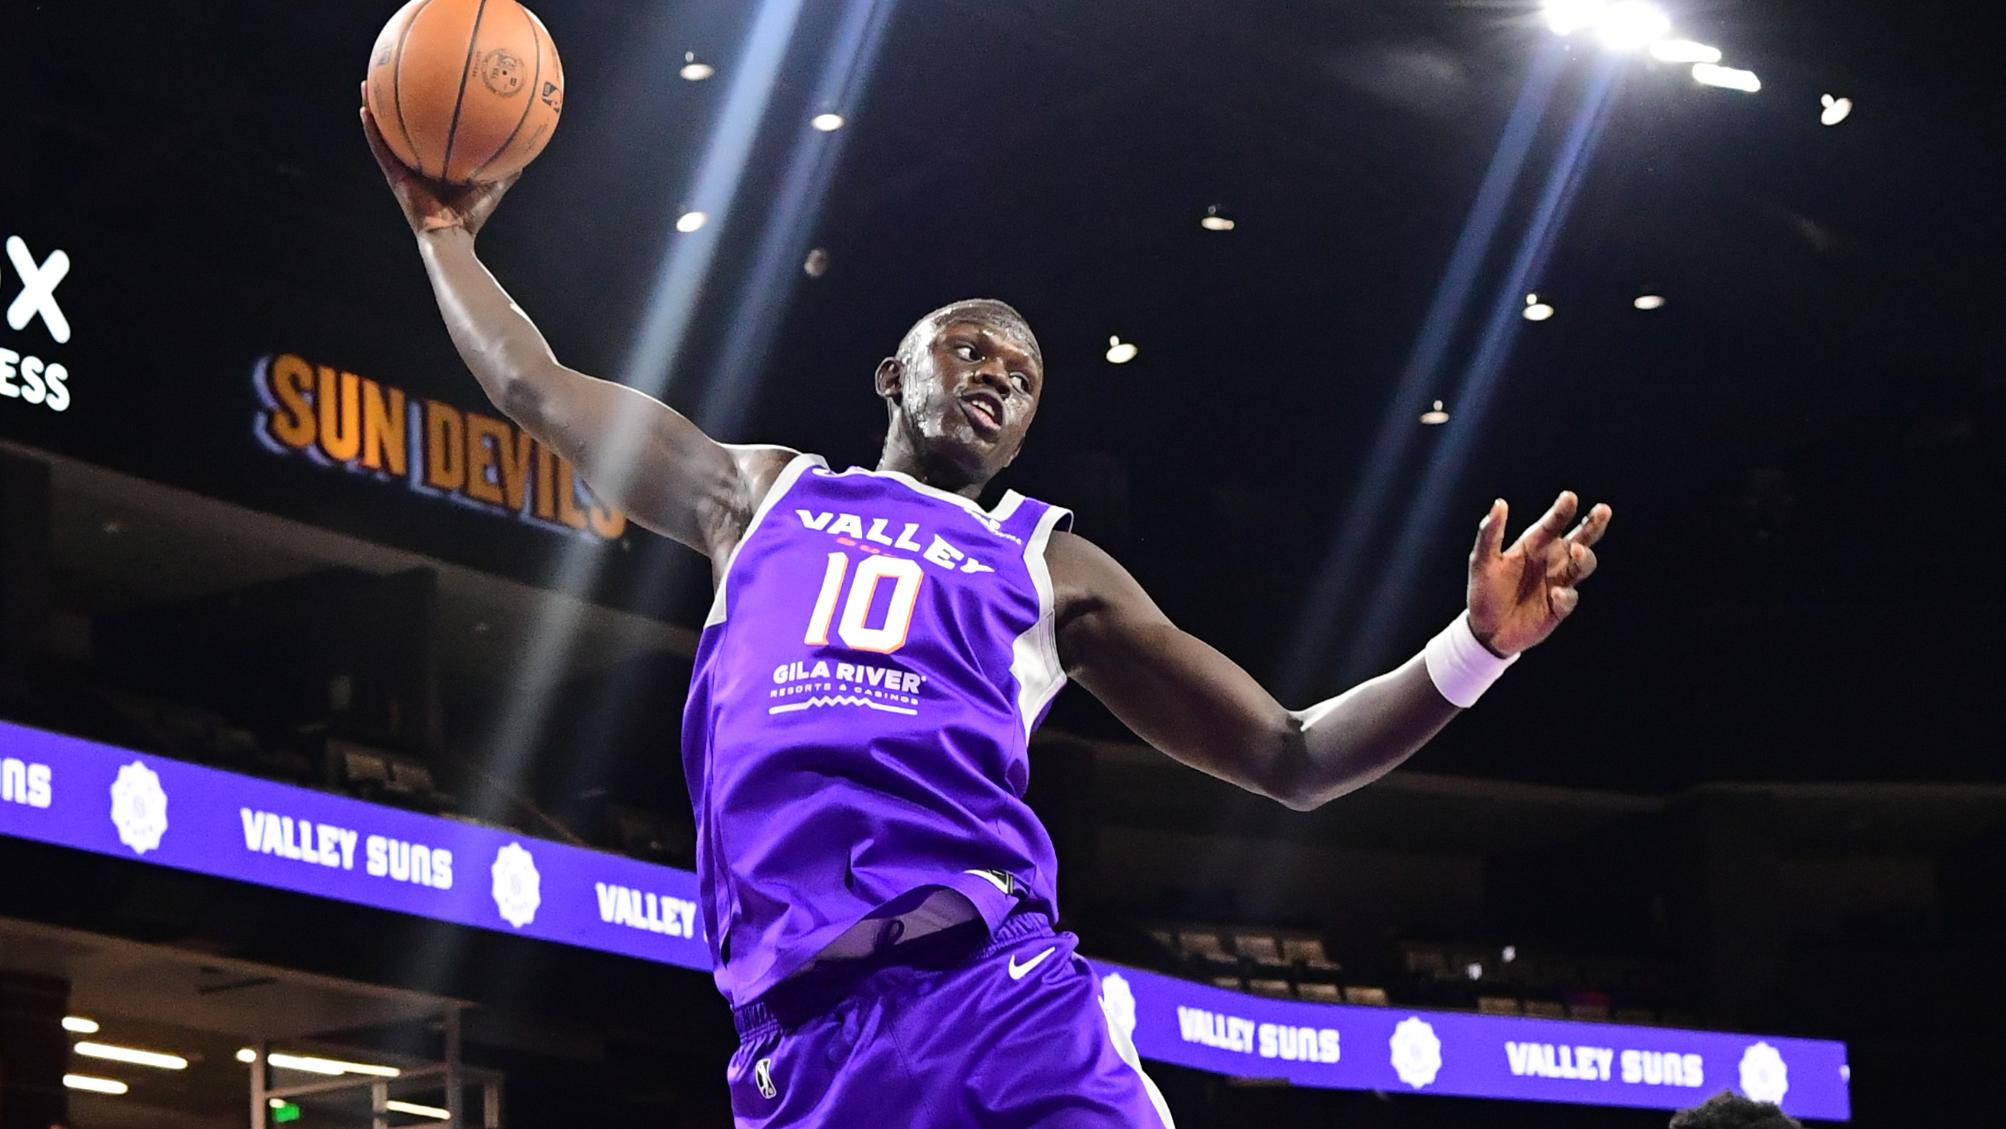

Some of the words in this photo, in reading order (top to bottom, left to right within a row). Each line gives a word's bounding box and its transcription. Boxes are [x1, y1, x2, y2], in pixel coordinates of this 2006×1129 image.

[0, 235, 71, 344] X
[262, 353, 407, 478] SUN
[795, 509, 995, 574] VALLEY
[803, 551, 924, 655] 10
[770, 683, 831, 698] RESORTS
[853, 686, 919, 705] CASINOS
[773, 661, 830, 684] GILA
[836, 662, 920, 694] RIVER
[0, 757, 52, 808] NS
[240, 807, 358, 871] VALLEY
[595, 882, 697, 939] VALLEY
[1177, 1005, 1255, 1054] VALLEY
[1504, 1041, 1613, 1081] VALLEY
